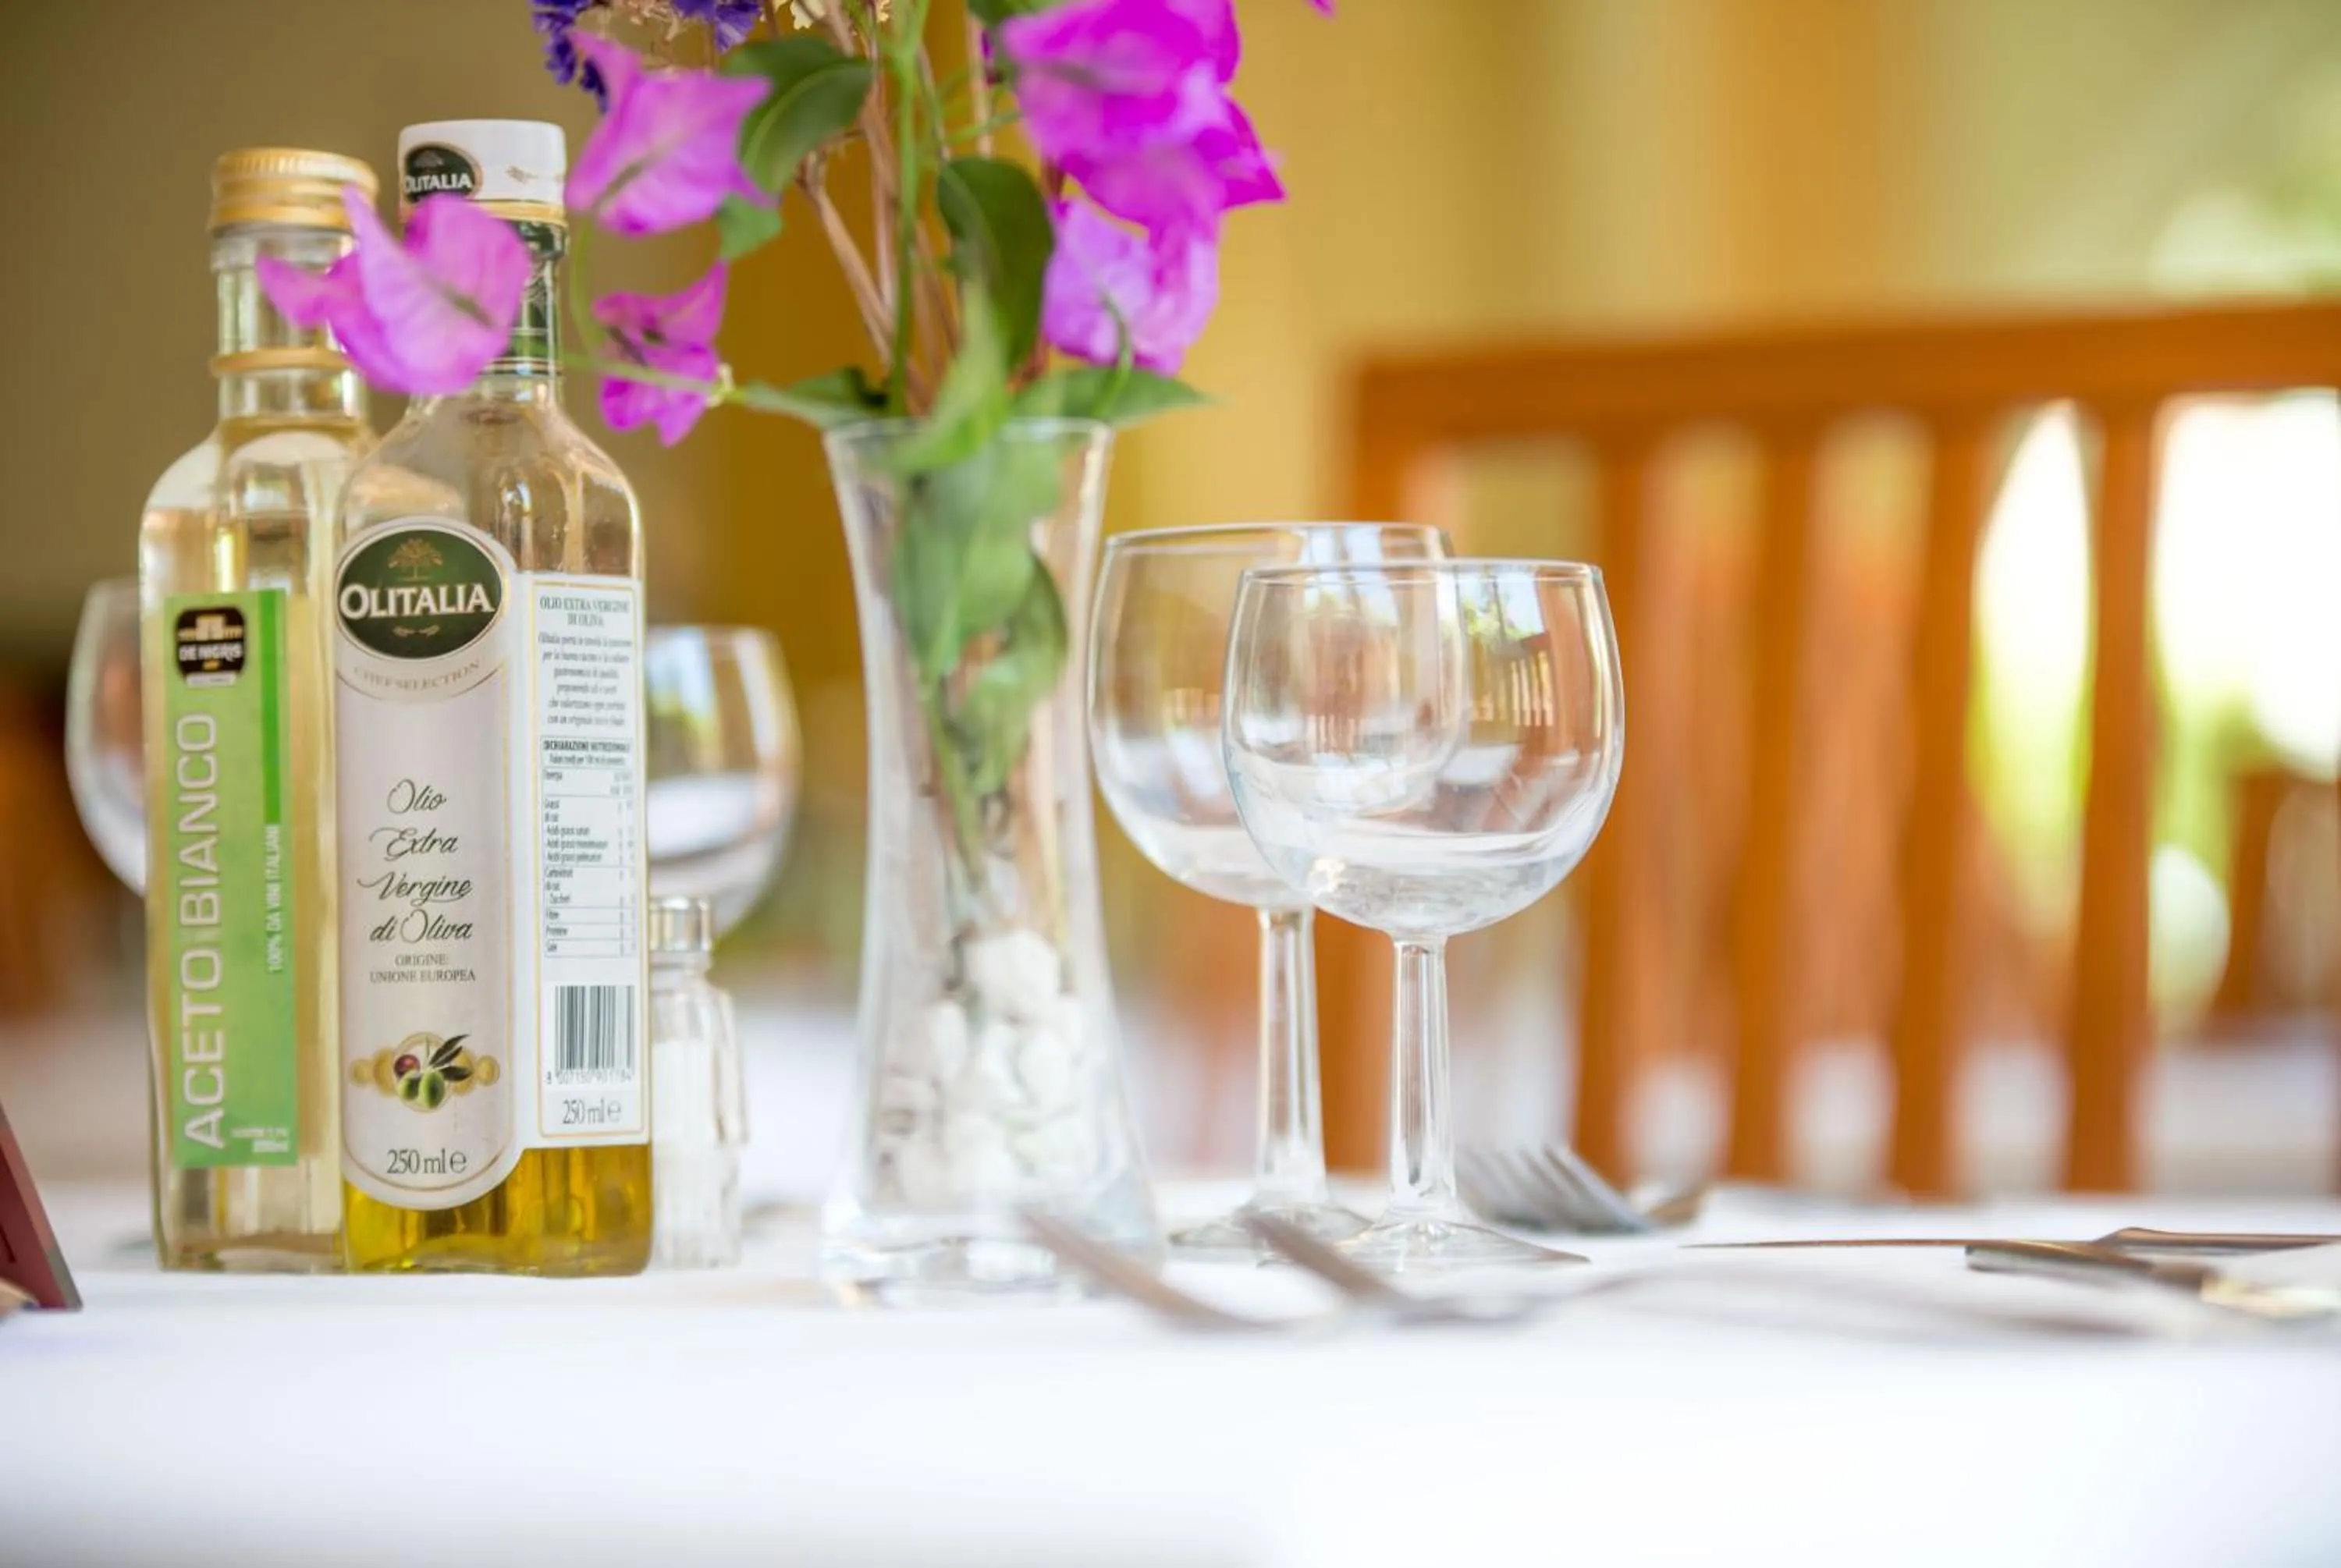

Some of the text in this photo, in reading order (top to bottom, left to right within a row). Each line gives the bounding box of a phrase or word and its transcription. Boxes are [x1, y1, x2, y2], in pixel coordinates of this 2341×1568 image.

[403, 172, 473, 193] OLITALIA
[339, 583, 496, 620] OLITALIA
[387, 779, 447, 814] Olio
[176, 712, 221, 927] BIANCO
[368, 827, 458, 861] Extra
[357, 871, 473, 907] Vergine
[370, 908, 473, 944] di Oliva
[370, 968, 476, 984] UNIONE EUROPEA
[394, 953, 449, 967] ORIGINE:
[180, 947, 225, 1150] ACETO
[562, 1098, 585, 1124] 250
[386, 1148, 421, 1174] 250
[423, 1148, 447, 1174] ml
